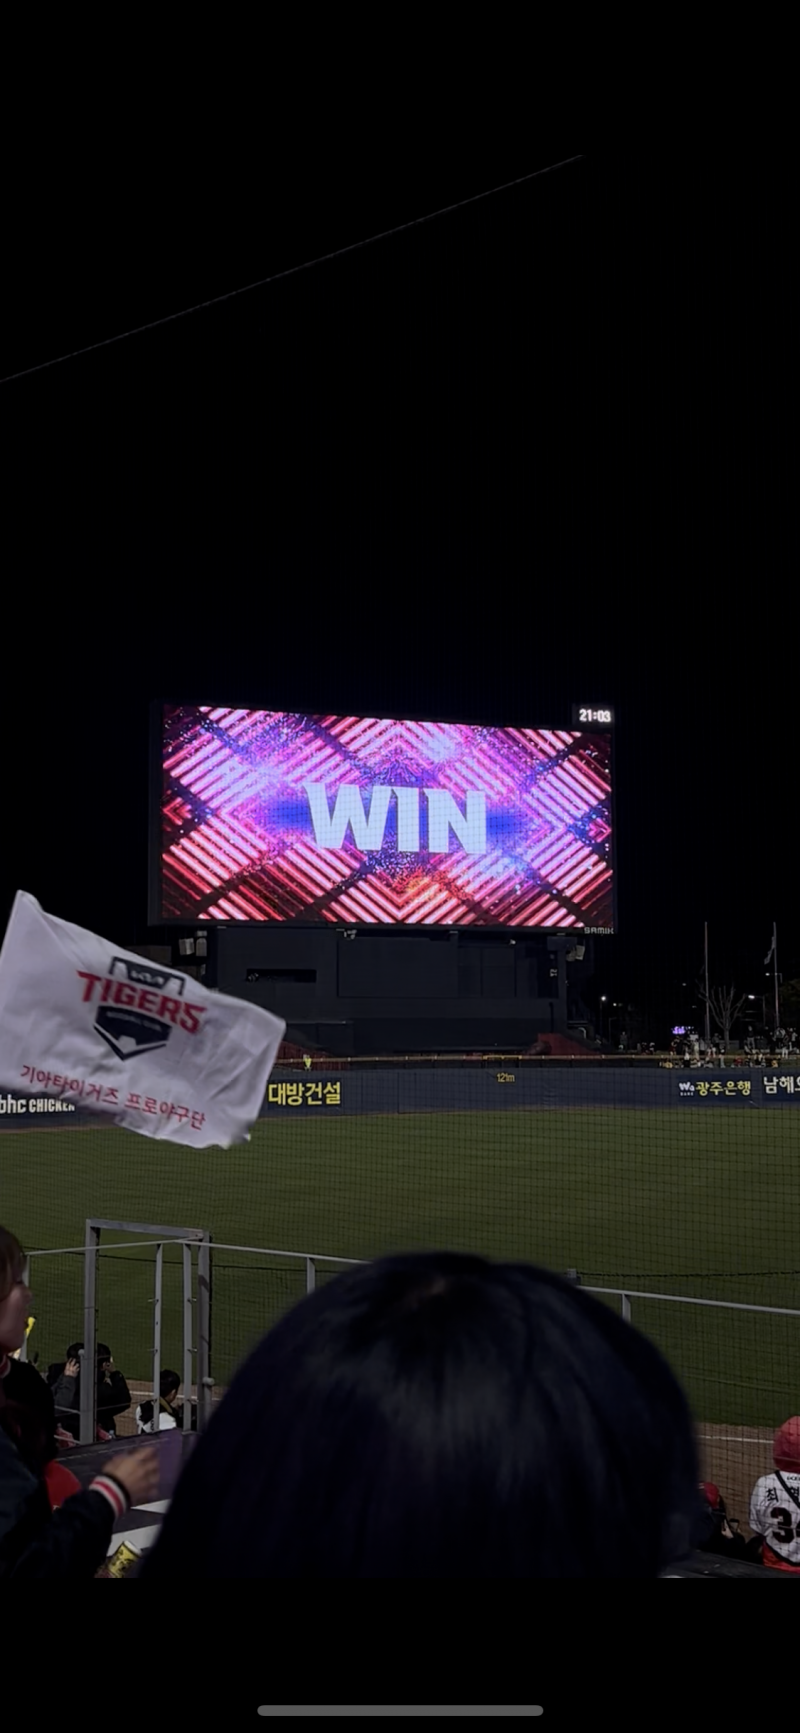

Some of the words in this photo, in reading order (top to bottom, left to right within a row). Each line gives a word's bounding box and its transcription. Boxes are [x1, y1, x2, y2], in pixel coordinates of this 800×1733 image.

[579, 708, 611, 722] 21:03
[302, 781, 487, 855] WIN
[76, 970, 207, 1034] TIGERS
[496, 1072, 515, 1083] 121m
[695, 1080, 752, 1097] 광주은행
[20, 1065, 119, 1105] 기아타이거즈
[124, 1092, 206, 1131] 프로야구단
[268, 1080, 341, 1107] 대방건설
[770, 1507, 800, 1543] 3
